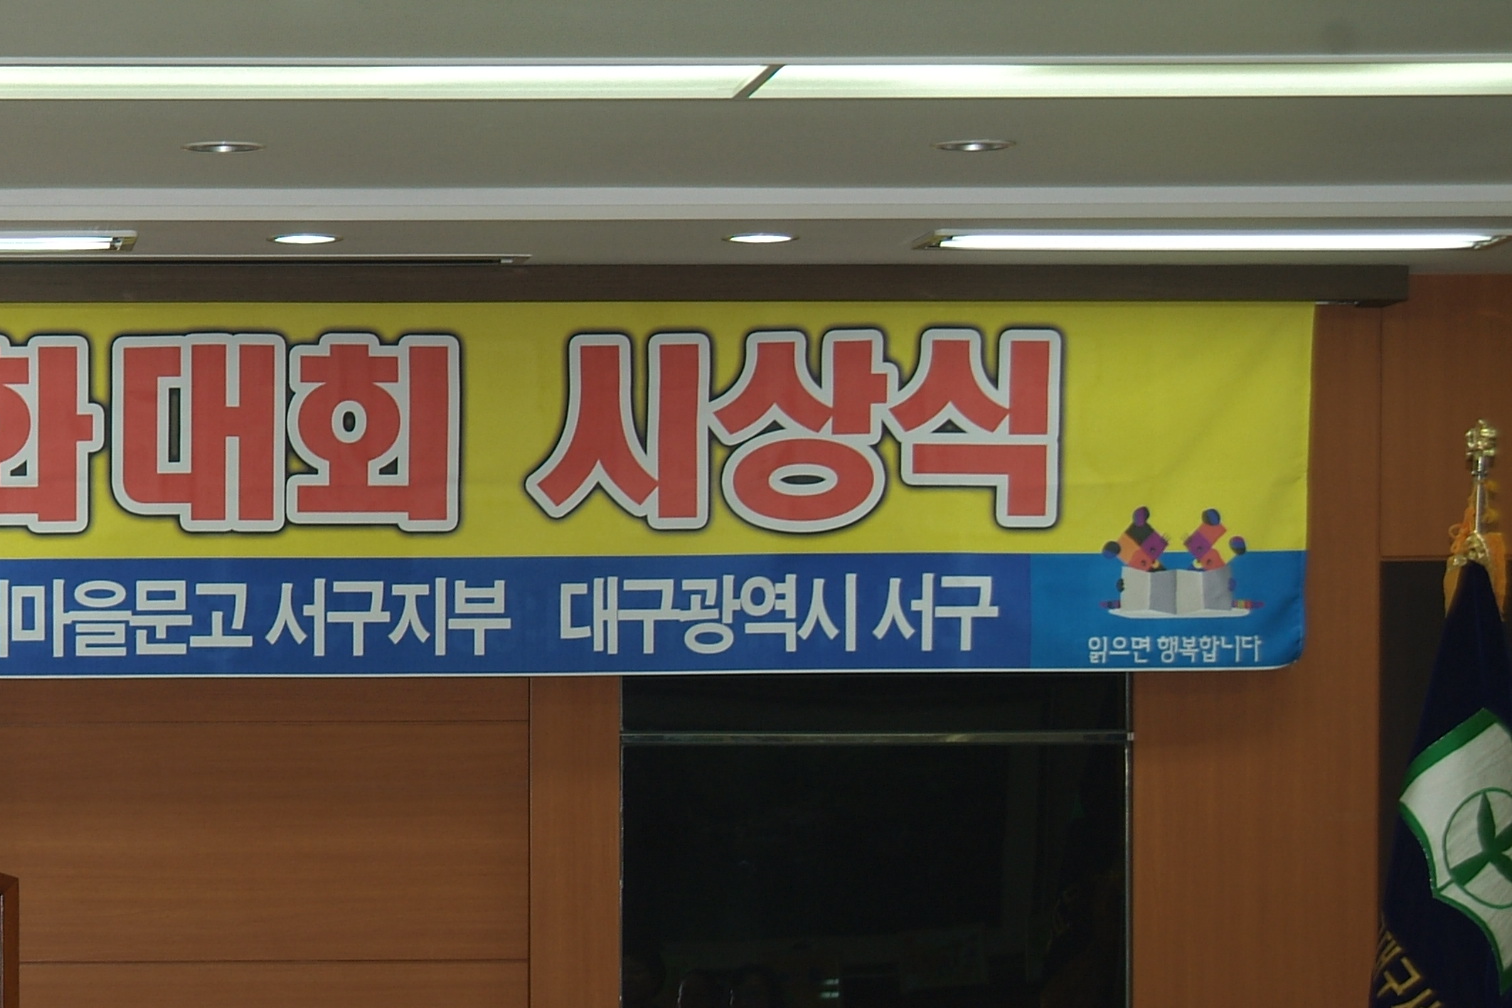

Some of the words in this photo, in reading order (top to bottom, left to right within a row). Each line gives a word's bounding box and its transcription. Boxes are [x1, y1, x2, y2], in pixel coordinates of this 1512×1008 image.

[526, 328, 1061, 532] 시상식
[265, 577, 512, 657] 서구지부
[560, 573, 857, 655] 대구광역시
[872, 572, 1000, 652] 서구
[1088, 636, 1151, 664] 읽으면
[1157, 635, 1262, 663] 행복합니다
